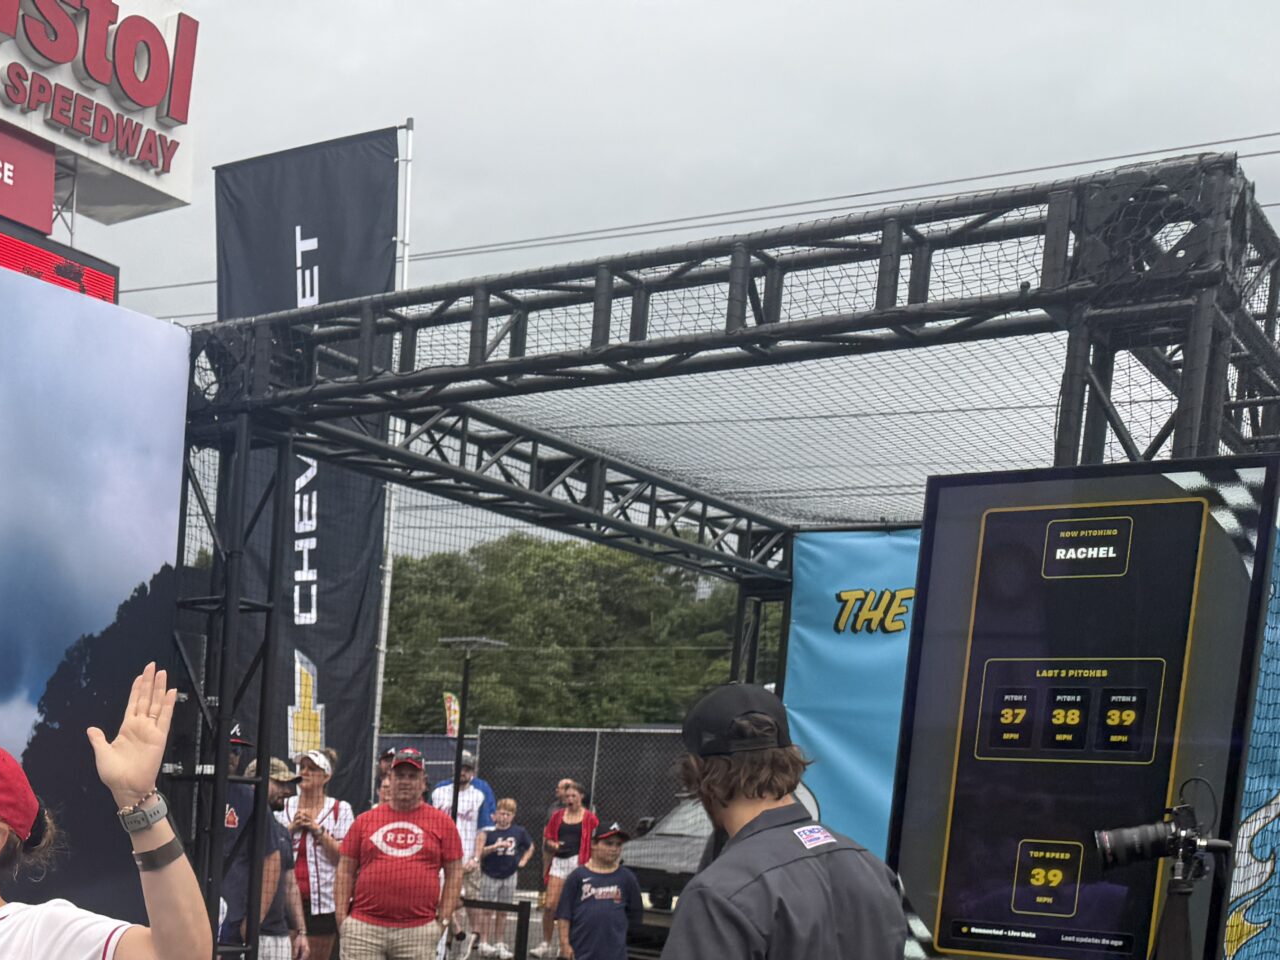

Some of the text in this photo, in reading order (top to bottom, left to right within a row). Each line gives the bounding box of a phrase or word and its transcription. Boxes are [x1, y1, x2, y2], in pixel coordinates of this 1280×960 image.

[3, 62, 181, 174] SPEEDWAY
[294, 225, 319, 625] CHEVET
[1059, 530, 1079, 538] NOW
[1056, 546, 1117, 559] RACHEL
[834, 588, 916, 634] THE
[1036, 669, 1060, 677] LAST
[1068, 669, 1108, 677] PITCHES
[1000, 708, 1026, 724] 37
[1052, 709, 1081, 725] 38
[1106, 709, 1136, 726] 39
[386, 832, 423, 844] REDS
[1030, 868, 1063, 886] 39
